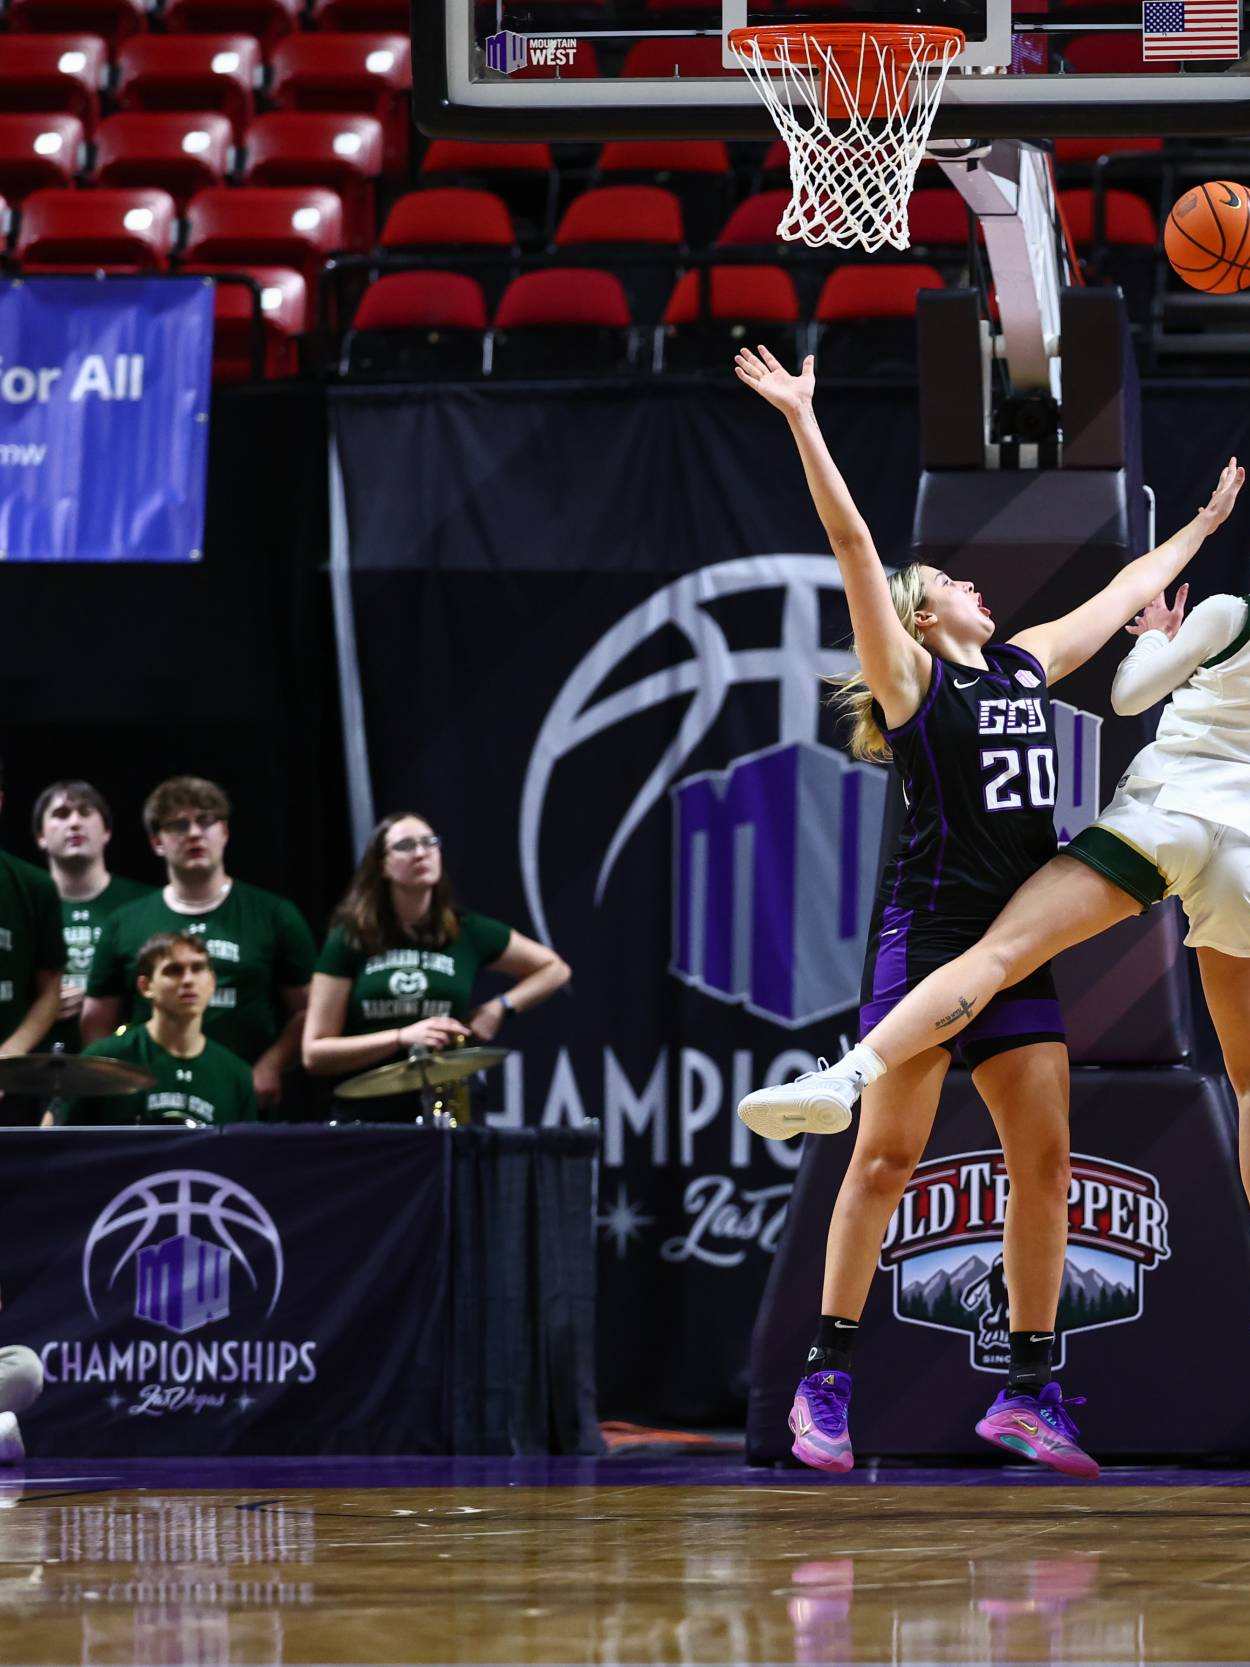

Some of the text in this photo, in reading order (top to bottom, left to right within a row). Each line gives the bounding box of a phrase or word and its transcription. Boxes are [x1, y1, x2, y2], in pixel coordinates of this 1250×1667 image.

[529, 39, 577, 48] MOUNTAIN
[530, 49, 577, 65] WEST
[0, 354, 144, 404] or All
[979, 698, 1047, 735] GCU
[981, 748, 1057, 810] 20
[41, 1341, 316, 1383] CHAMPIONSHIPS
